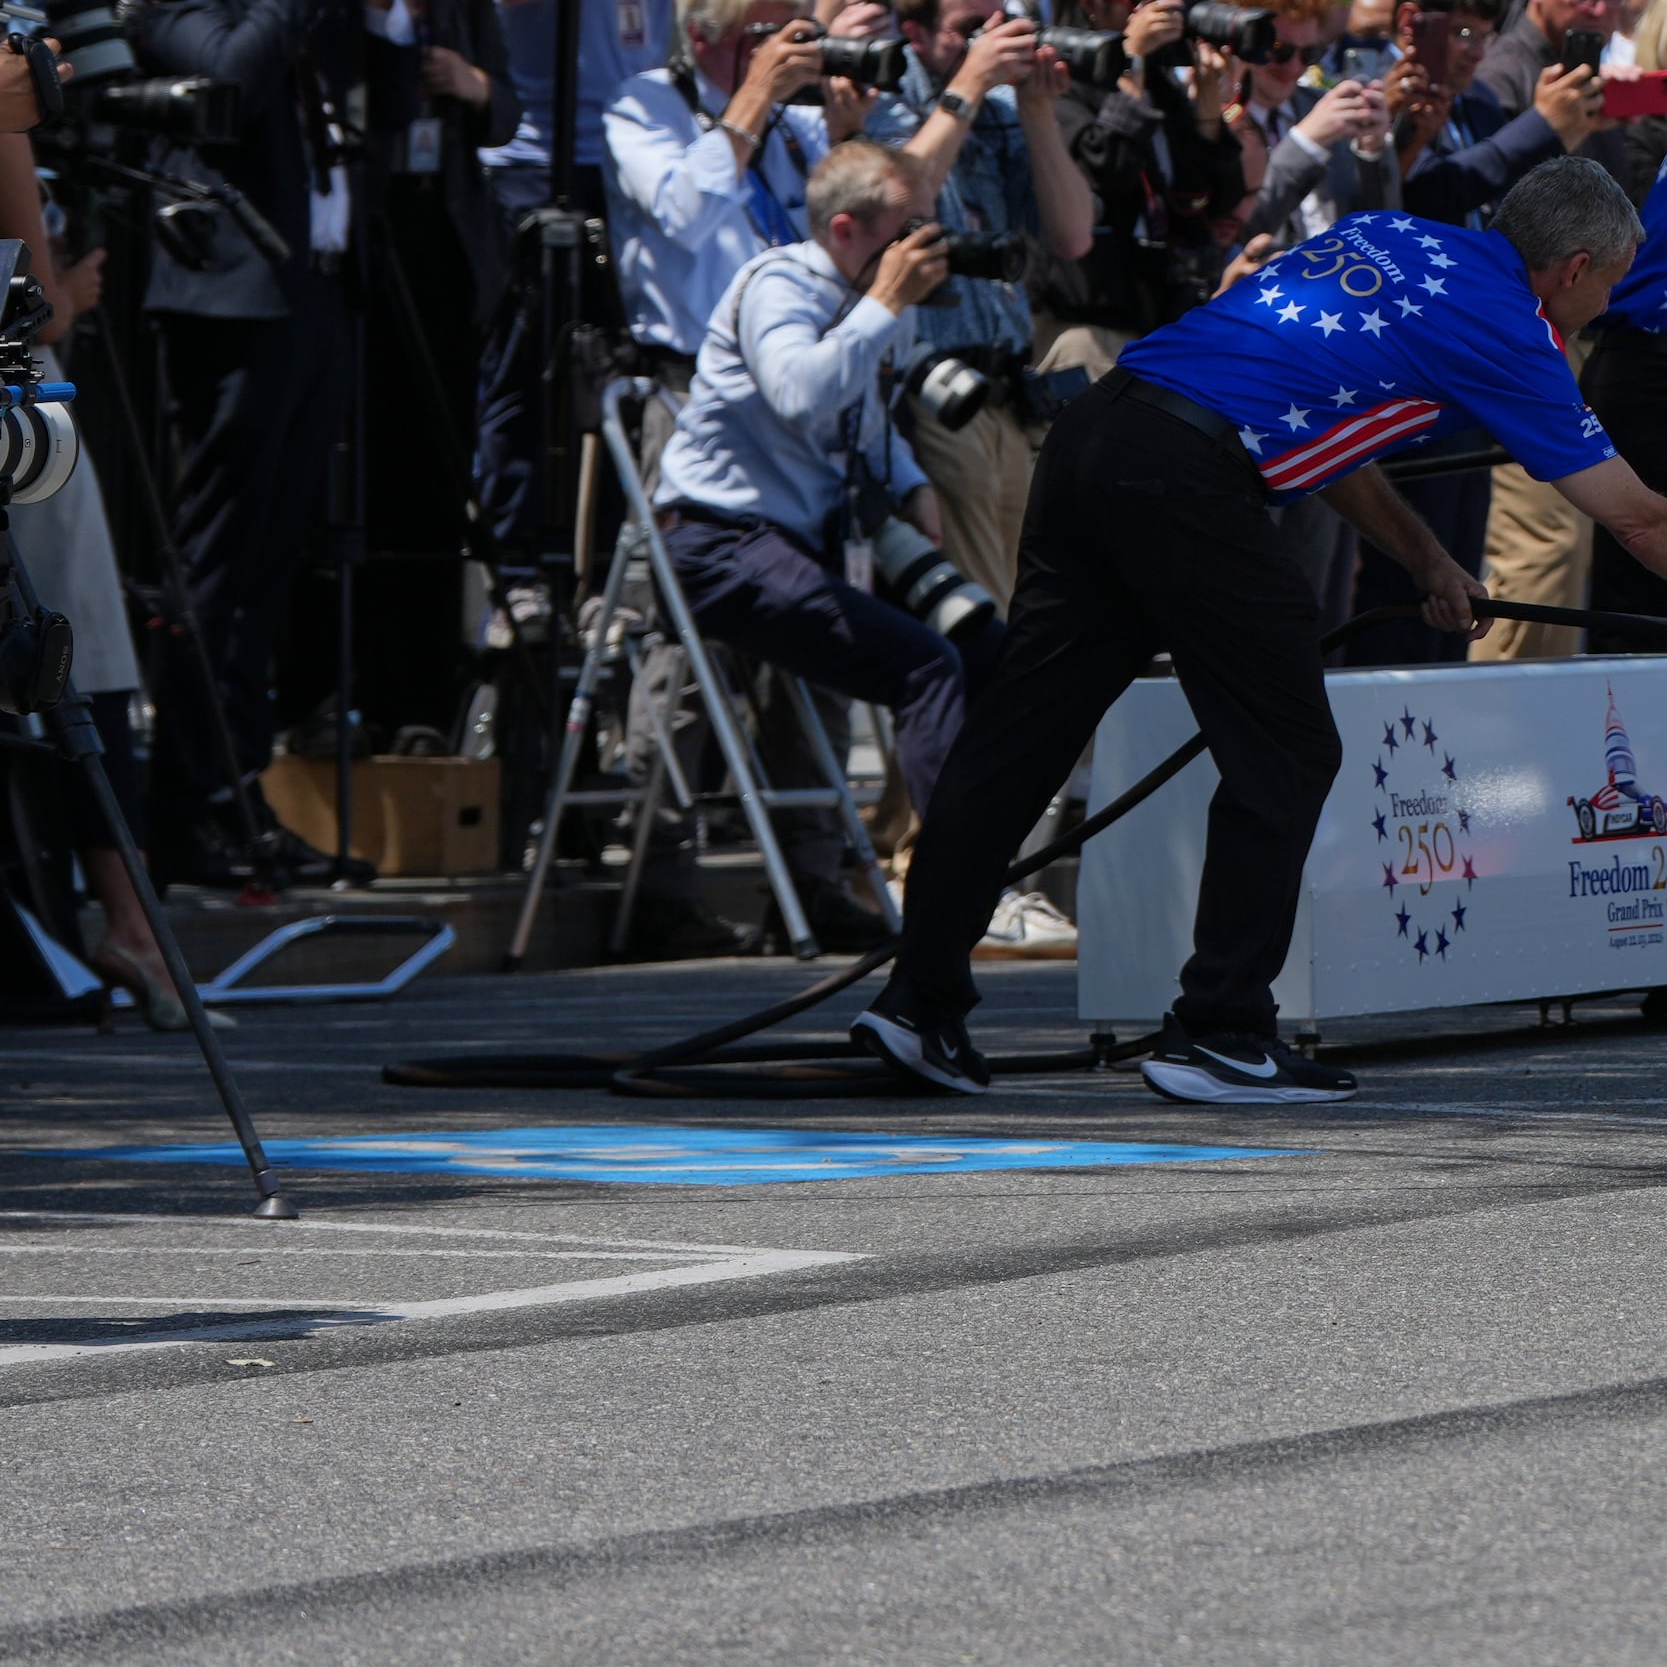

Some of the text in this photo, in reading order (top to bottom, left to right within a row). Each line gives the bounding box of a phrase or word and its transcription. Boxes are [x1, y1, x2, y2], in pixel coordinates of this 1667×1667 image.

[1300, 238, 1383, 297] 250
[1339, 227, 1405, 285] Freedom
[1580, 414, 1604, 438] 25
[1391, 789, 1449, 819] Freedom
[1609, 812, 1633, 825] INDYCAR
[1398, 820, 1455, 896] 250
[1568, 854, 1649, 898] Freedom
[1607, 897, 1664, 923] Grand Prix
